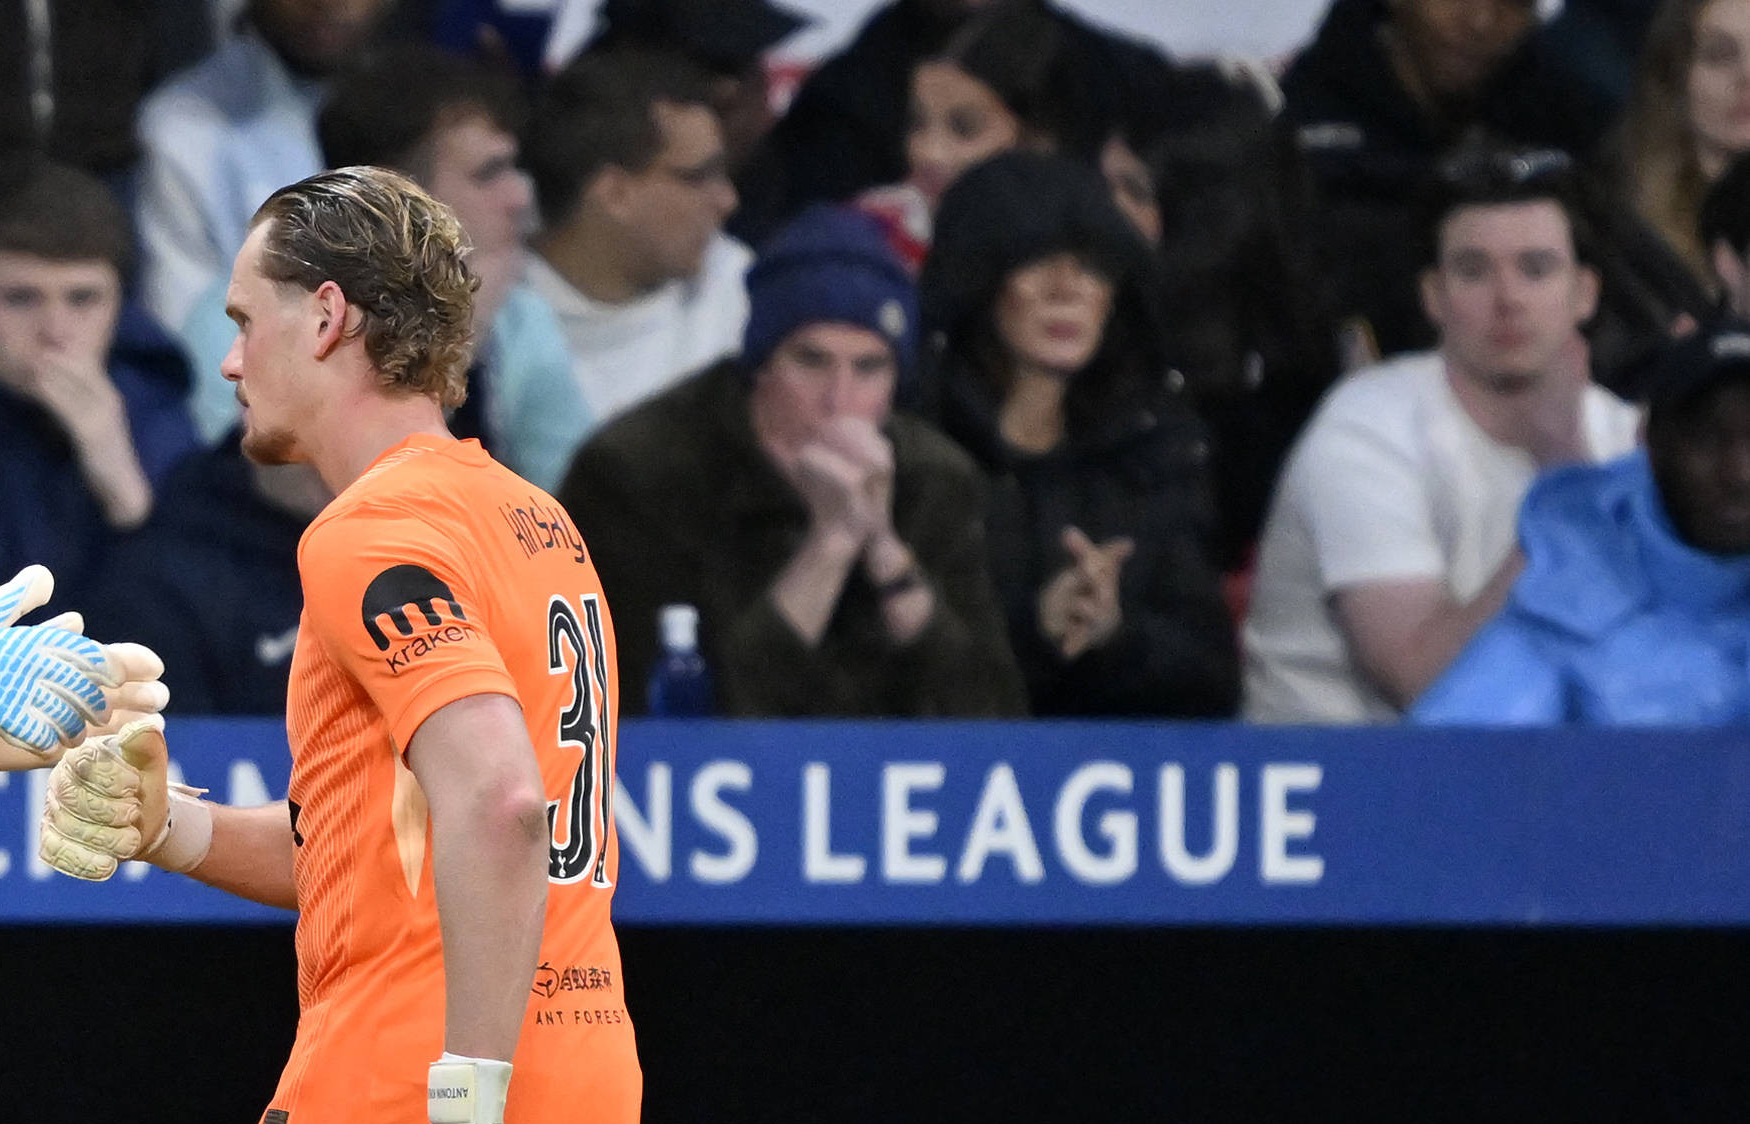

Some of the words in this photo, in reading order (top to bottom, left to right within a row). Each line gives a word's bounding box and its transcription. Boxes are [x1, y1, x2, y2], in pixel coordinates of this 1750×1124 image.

[386, 626, 481, 674] kraken
[546, 593, 613, 888] 31
[803, 760, 1327, 886] LEAGUE
[535, 1010, 565, 1025] ANT
